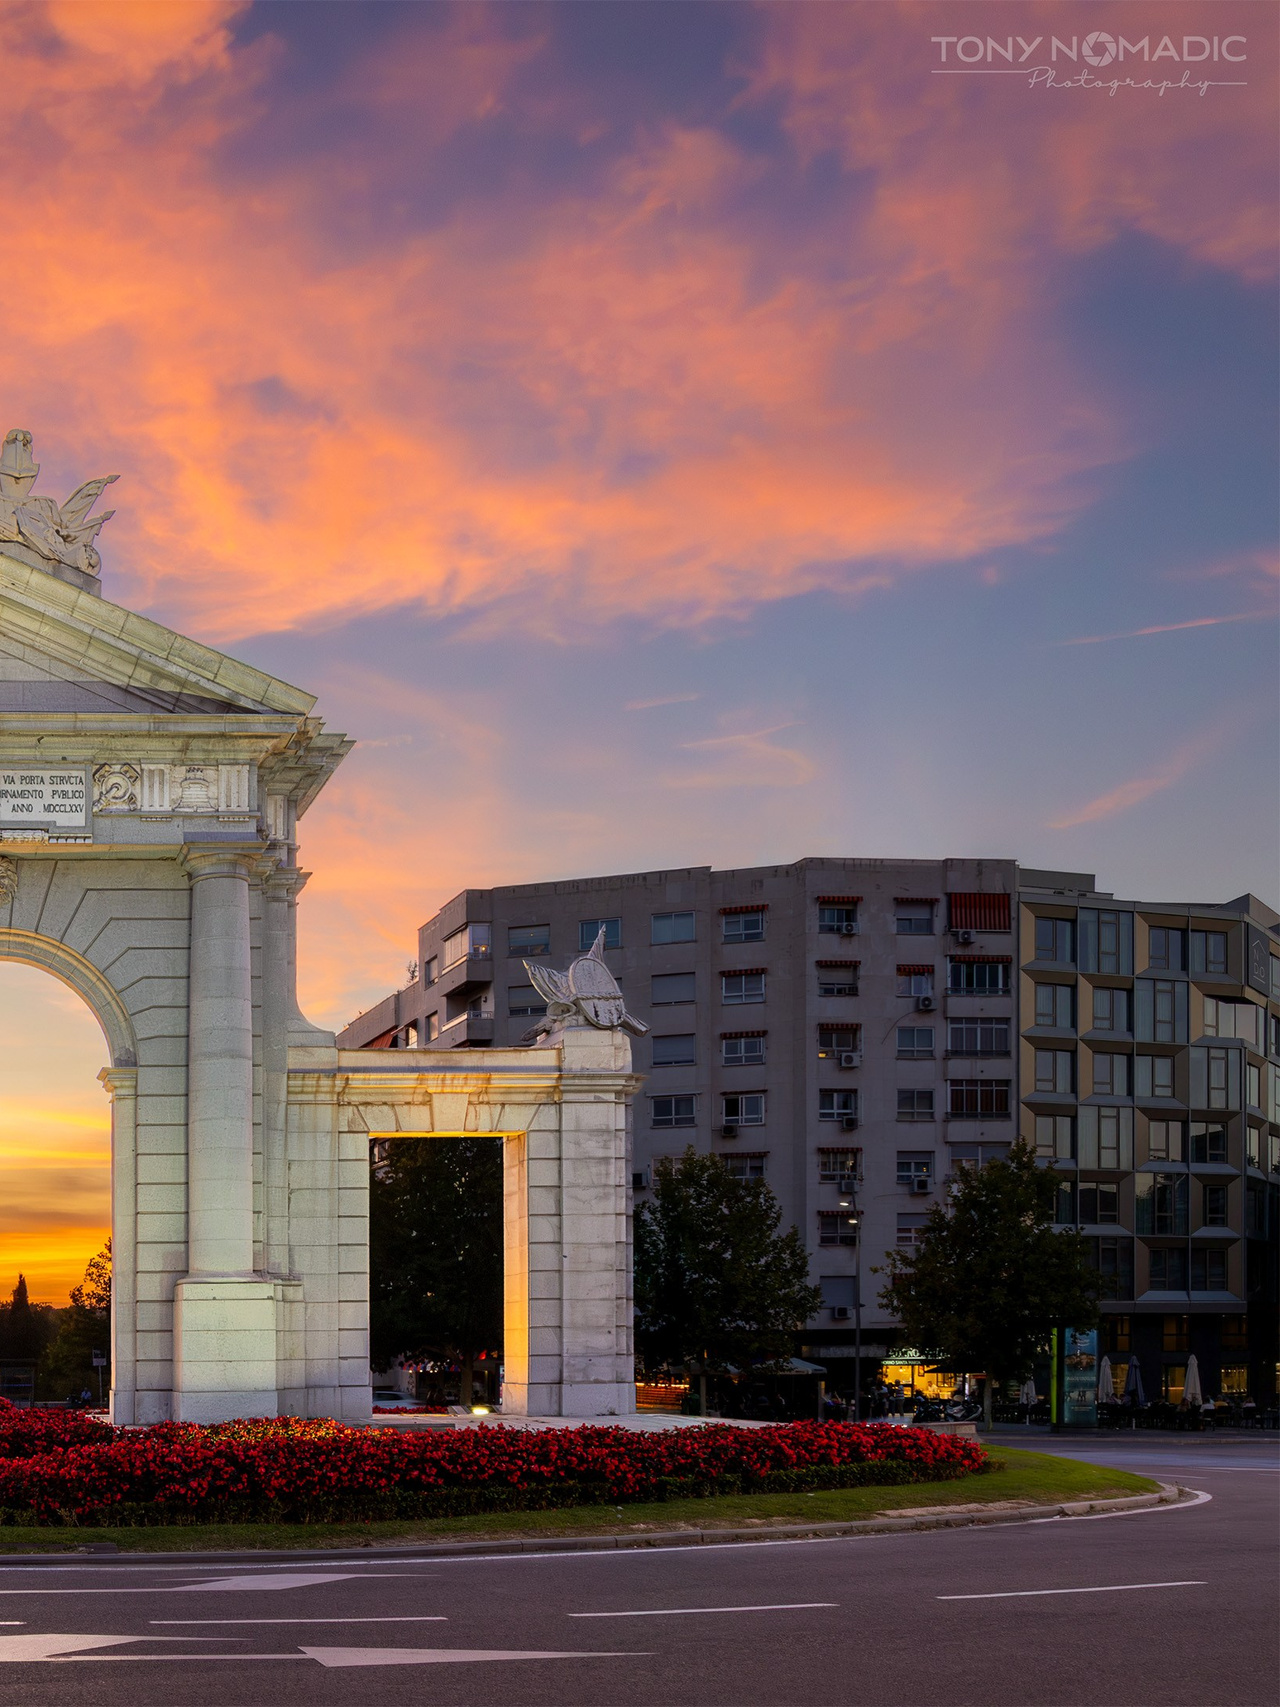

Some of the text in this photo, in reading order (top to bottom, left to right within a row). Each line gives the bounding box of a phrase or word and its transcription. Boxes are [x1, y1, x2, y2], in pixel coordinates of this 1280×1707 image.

[3, 775, 16, 785] VIA
[20, 775, 45, 785] PORTA
[49, 775, 84, 785] STRVCTA
[51, 789, 84, 800] PVBLICO
[11, 803, 34, 813] ANNO
[42, 803, 85, 813] MDCCLXXV
